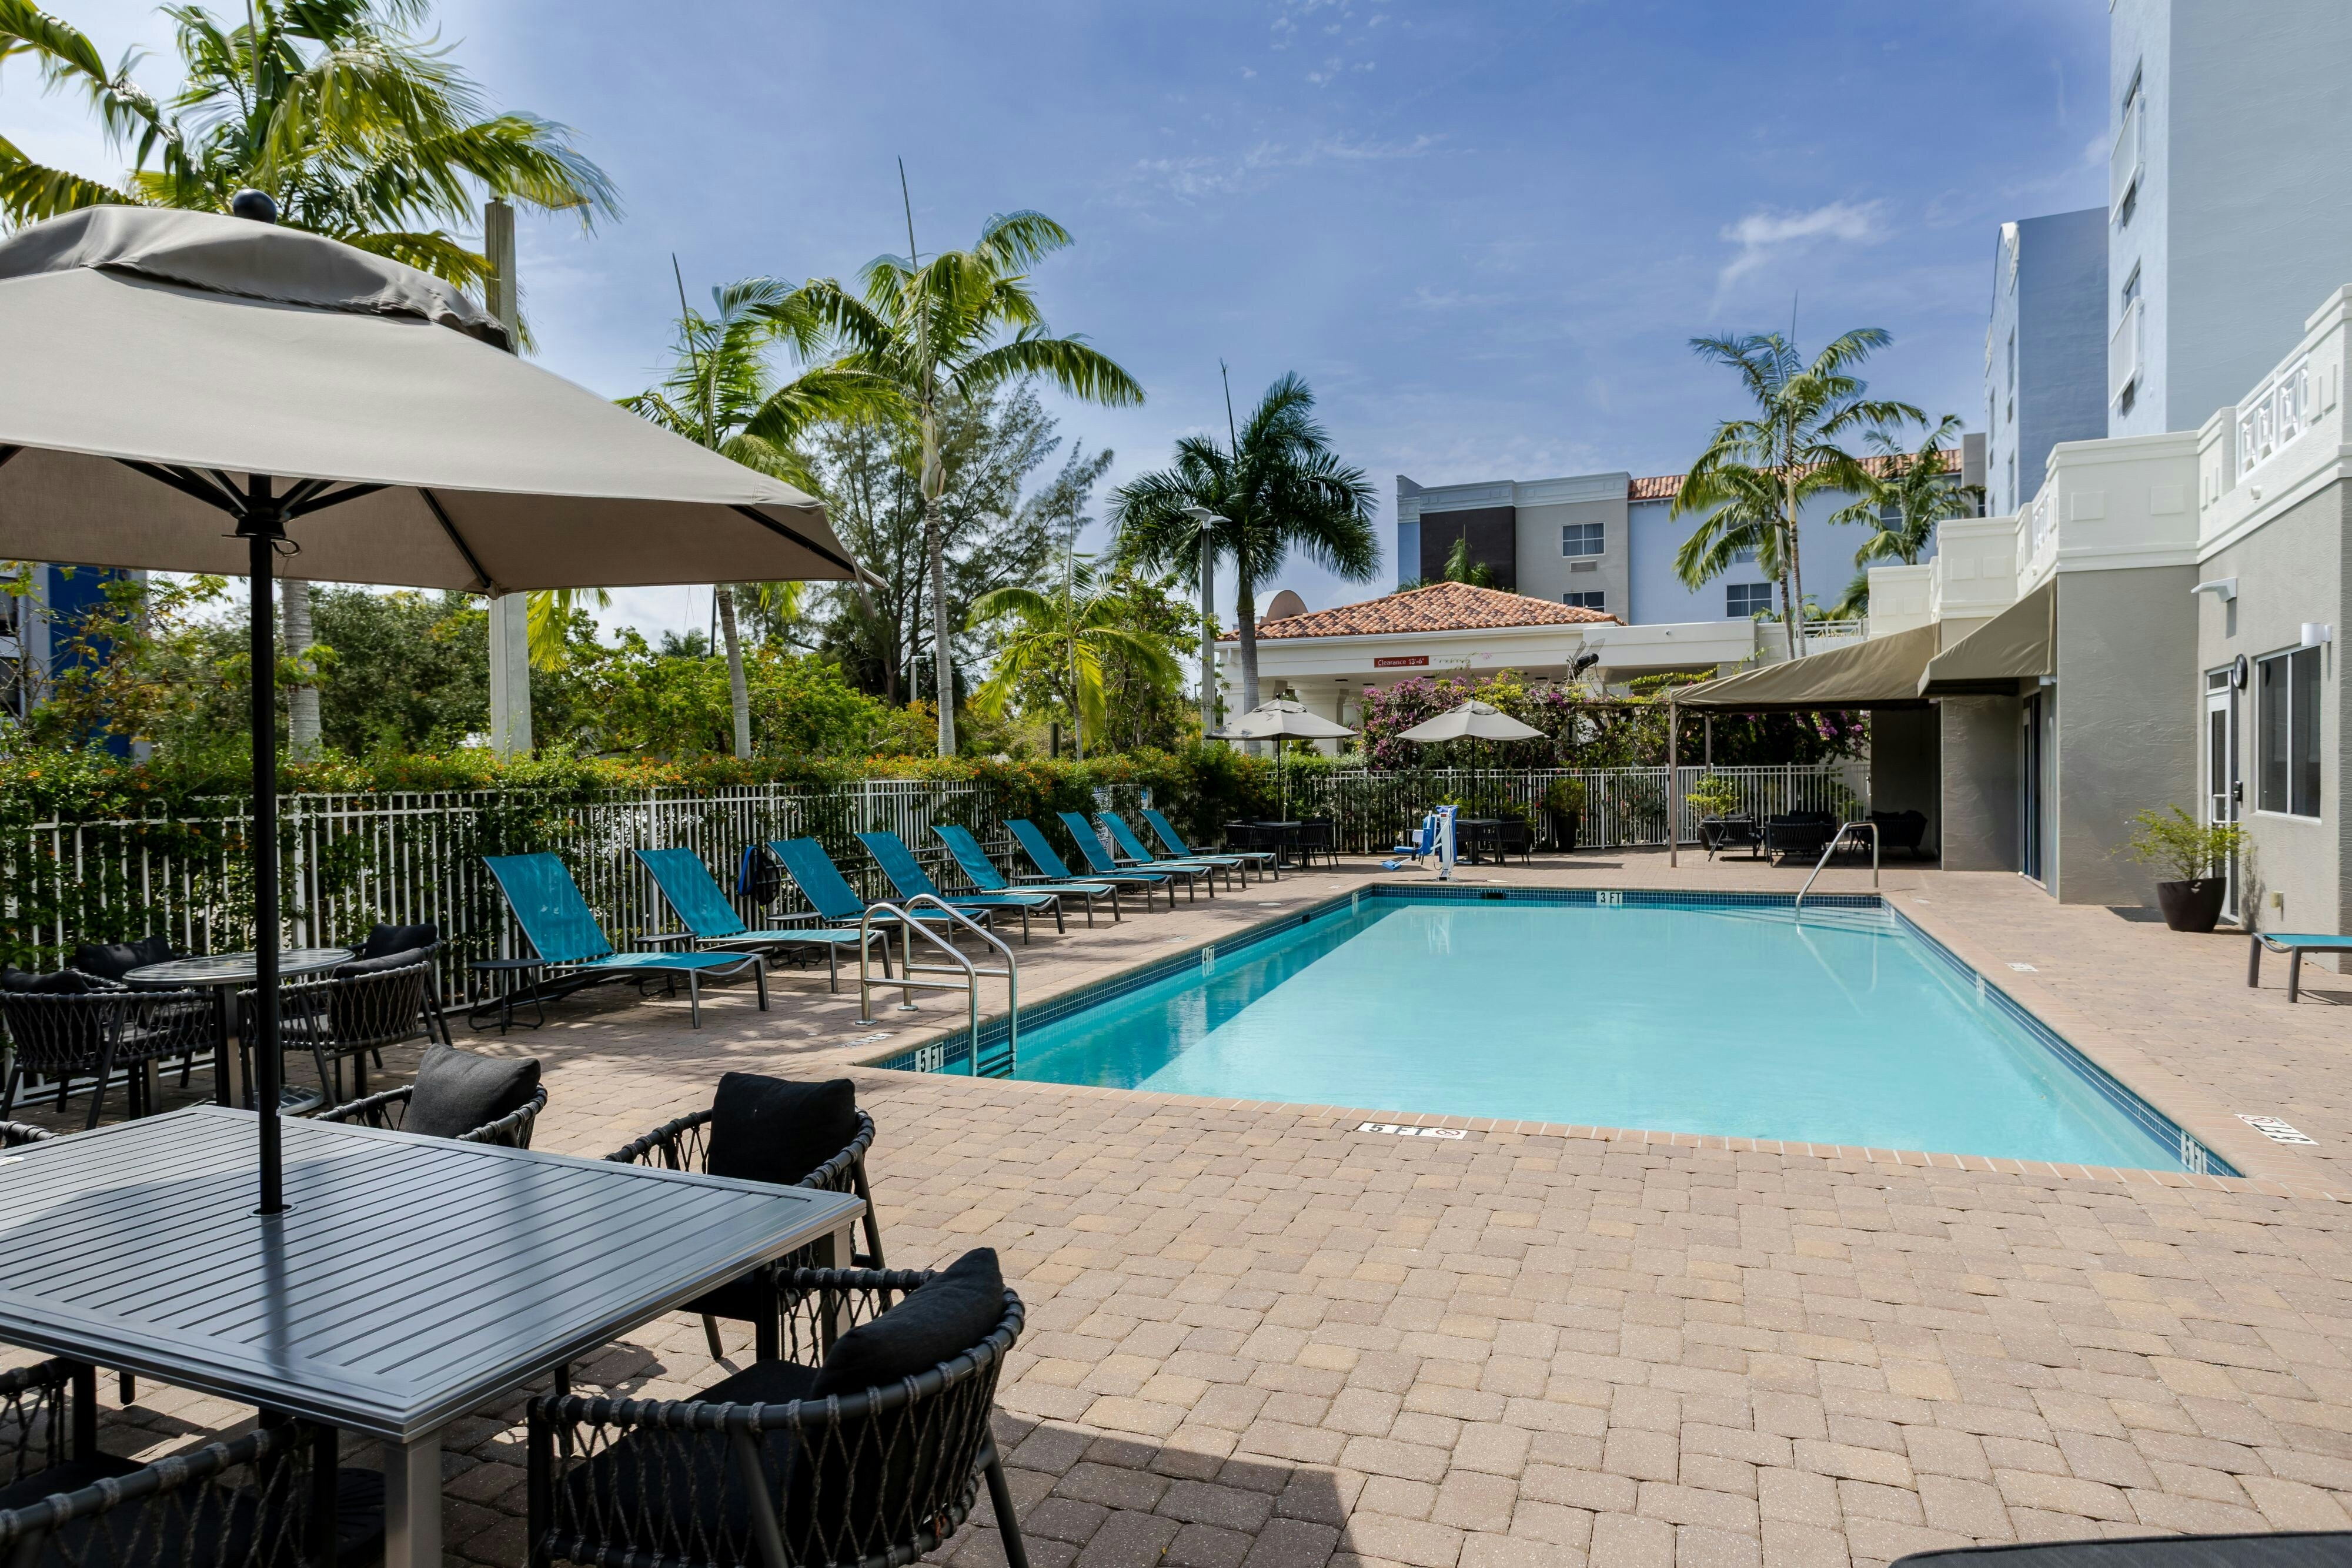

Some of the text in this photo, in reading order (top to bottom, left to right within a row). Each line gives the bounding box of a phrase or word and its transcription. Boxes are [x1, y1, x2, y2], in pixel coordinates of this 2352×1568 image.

[1601, 892, 1621, 904] 3 FT
[920, 1043, 943, 1072] 5 FT
[1369, 1124, 1430, 1136] 5 FT
[2185, 1134, 2204, 1175] 5 FT
